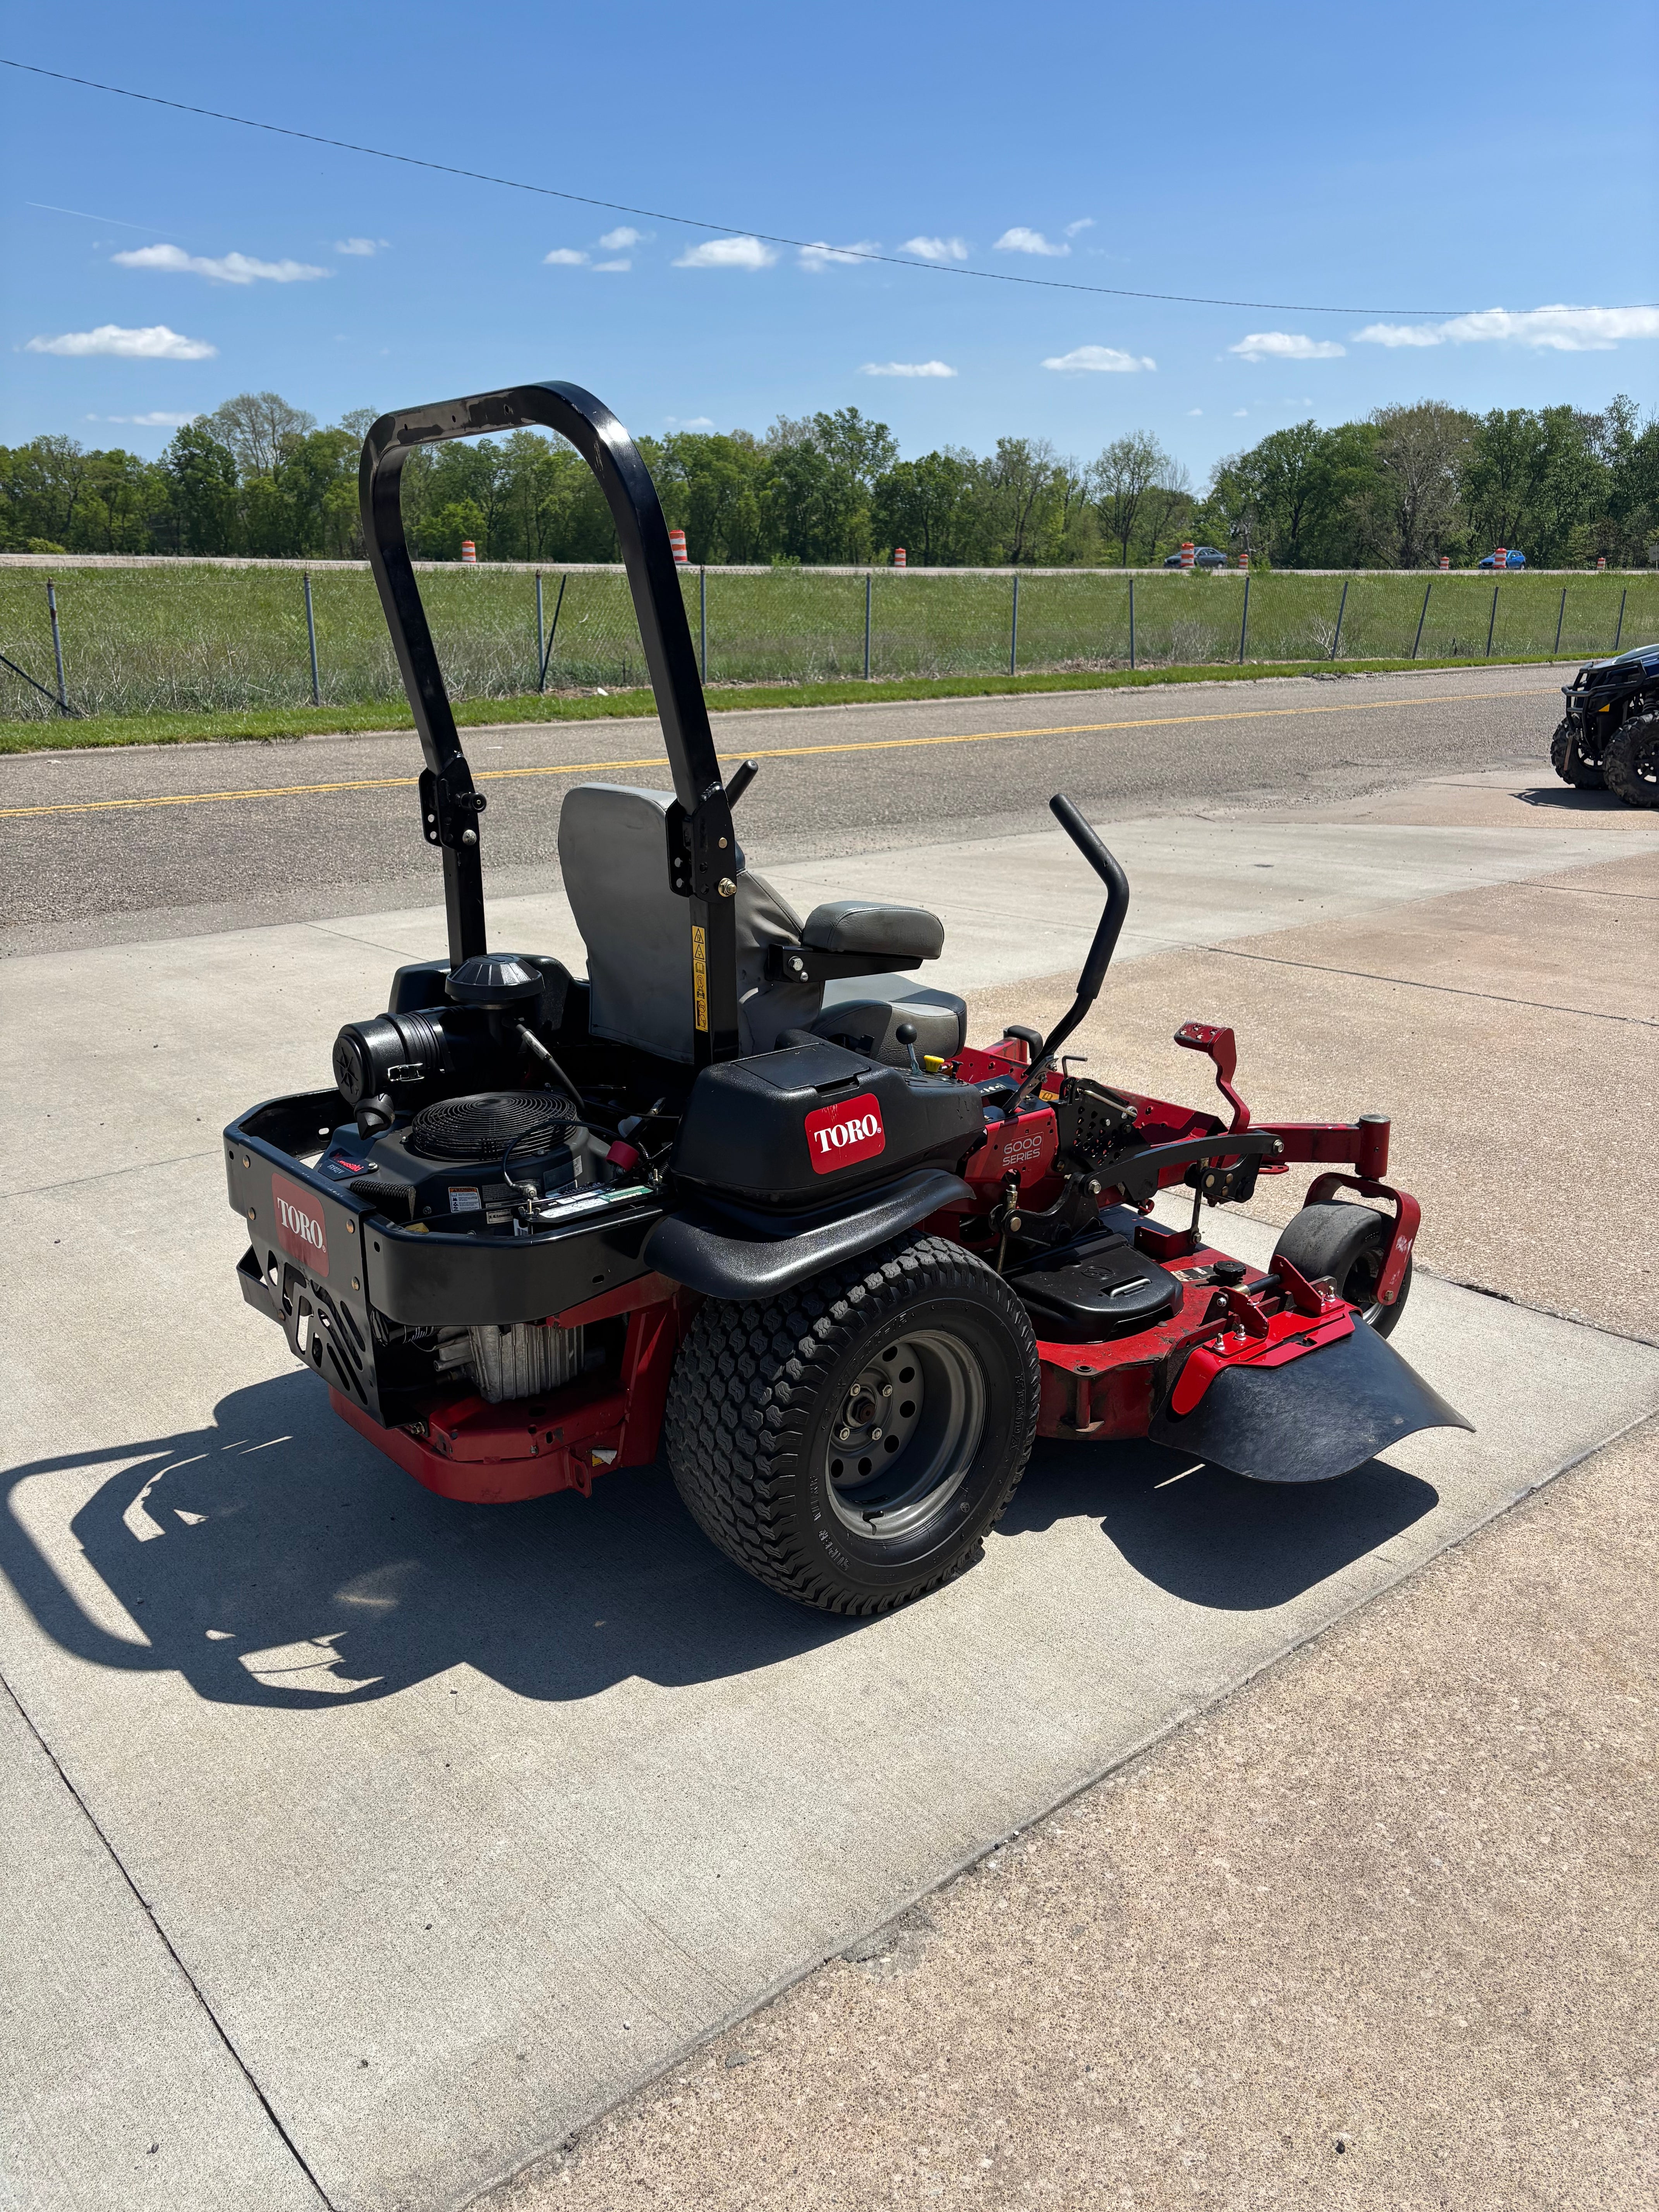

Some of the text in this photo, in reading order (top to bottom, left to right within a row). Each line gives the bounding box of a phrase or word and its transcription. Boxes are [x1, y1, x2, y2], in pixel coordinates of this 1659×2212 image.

[814, 1114, 878, 1153] TORO
[1004, 1135, 1042, 1154] 6000
[1002, 1148, 1040, 1166] SERIES
[277, 1197, 323, 1249] TORO
[818, 1528, 852, 1571] SUPER
